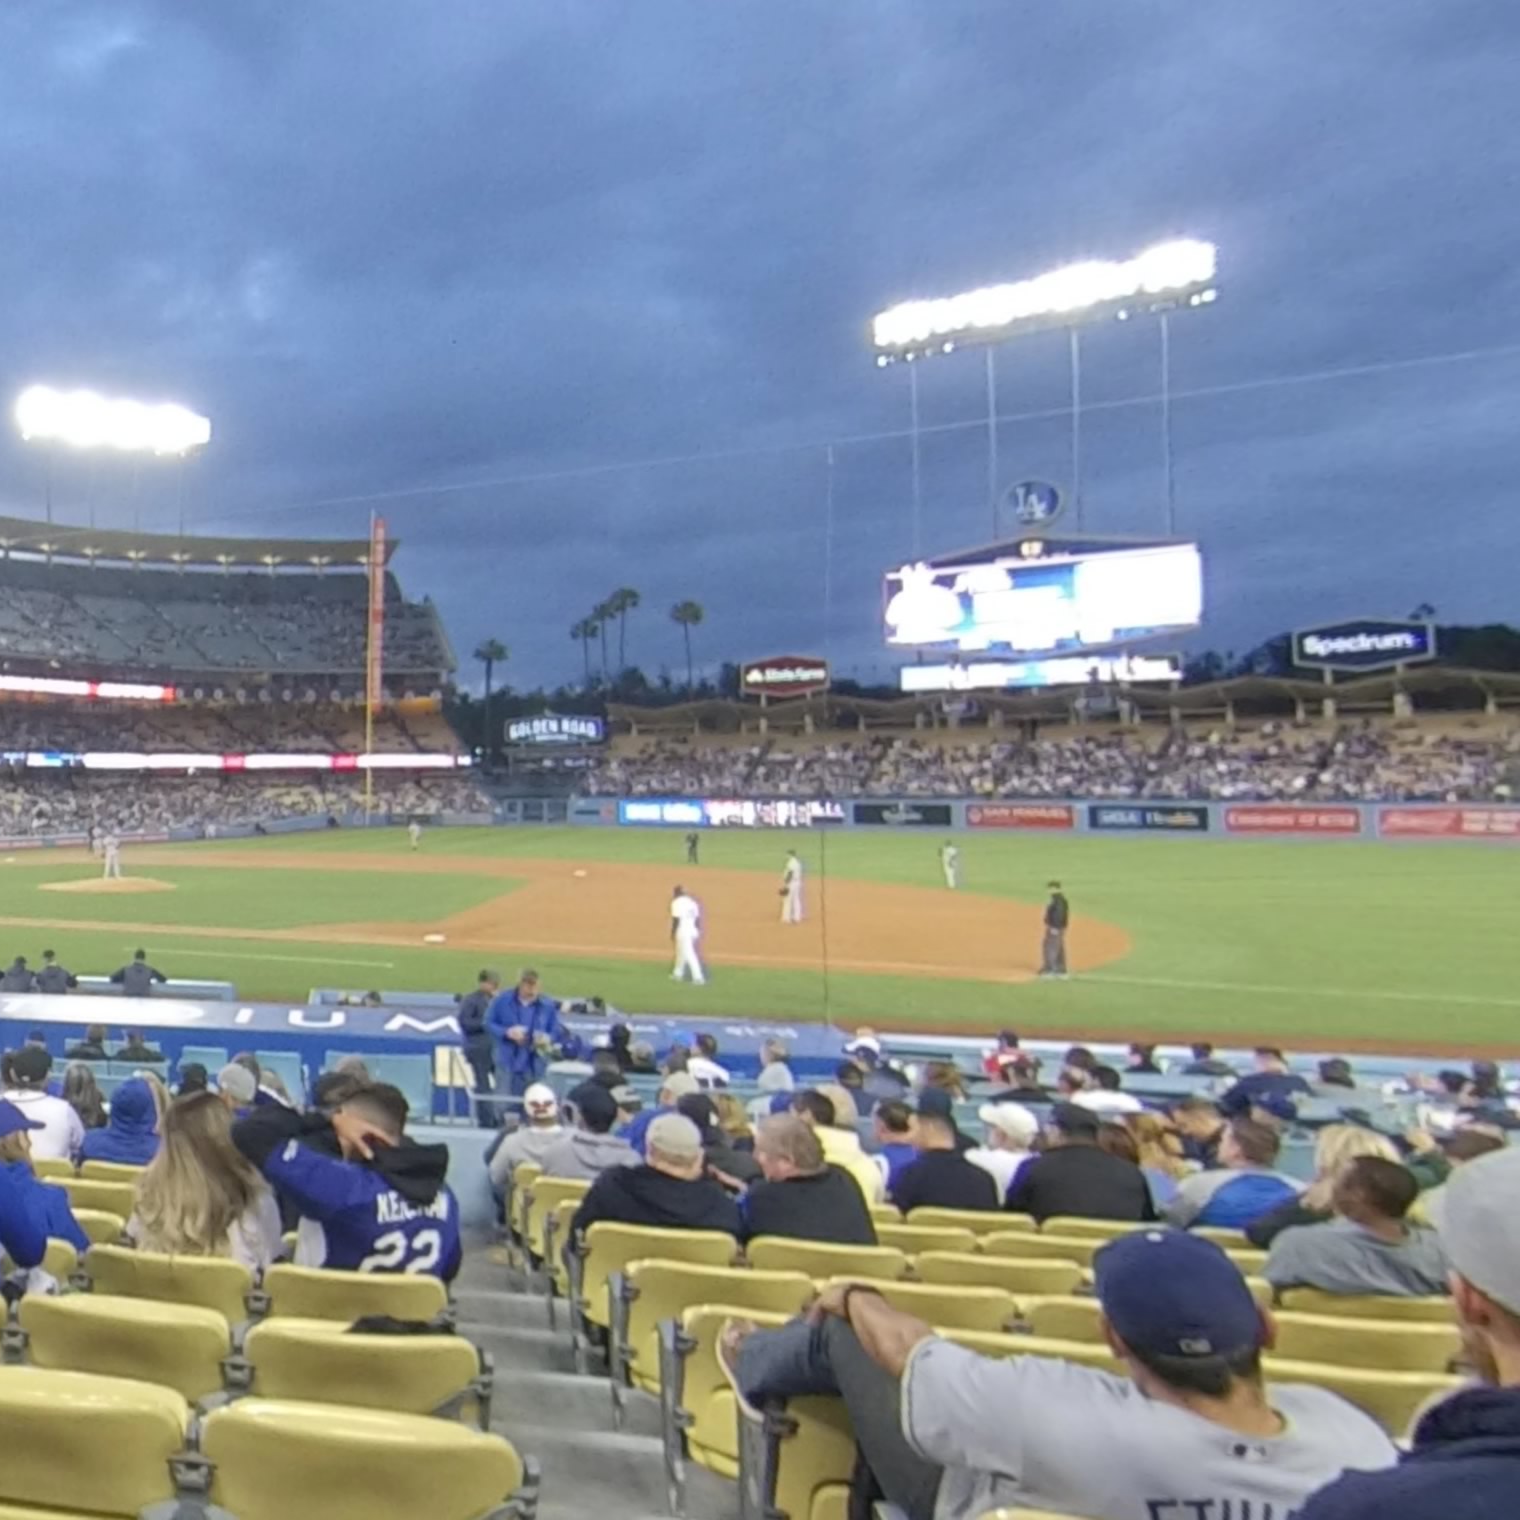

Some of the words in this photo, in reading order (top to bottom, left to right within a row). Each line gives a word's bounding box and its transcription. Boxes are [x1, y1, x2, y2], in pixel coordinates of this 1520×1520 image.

[1016, 486, 1046, 521] LA
[1302, 632, 1414, 657] Spectrum
[509, 719, 558, 739] GOLDEN
[561, 718, 597, 738] ROAD
[359, 1228, 441, 1273] 22
